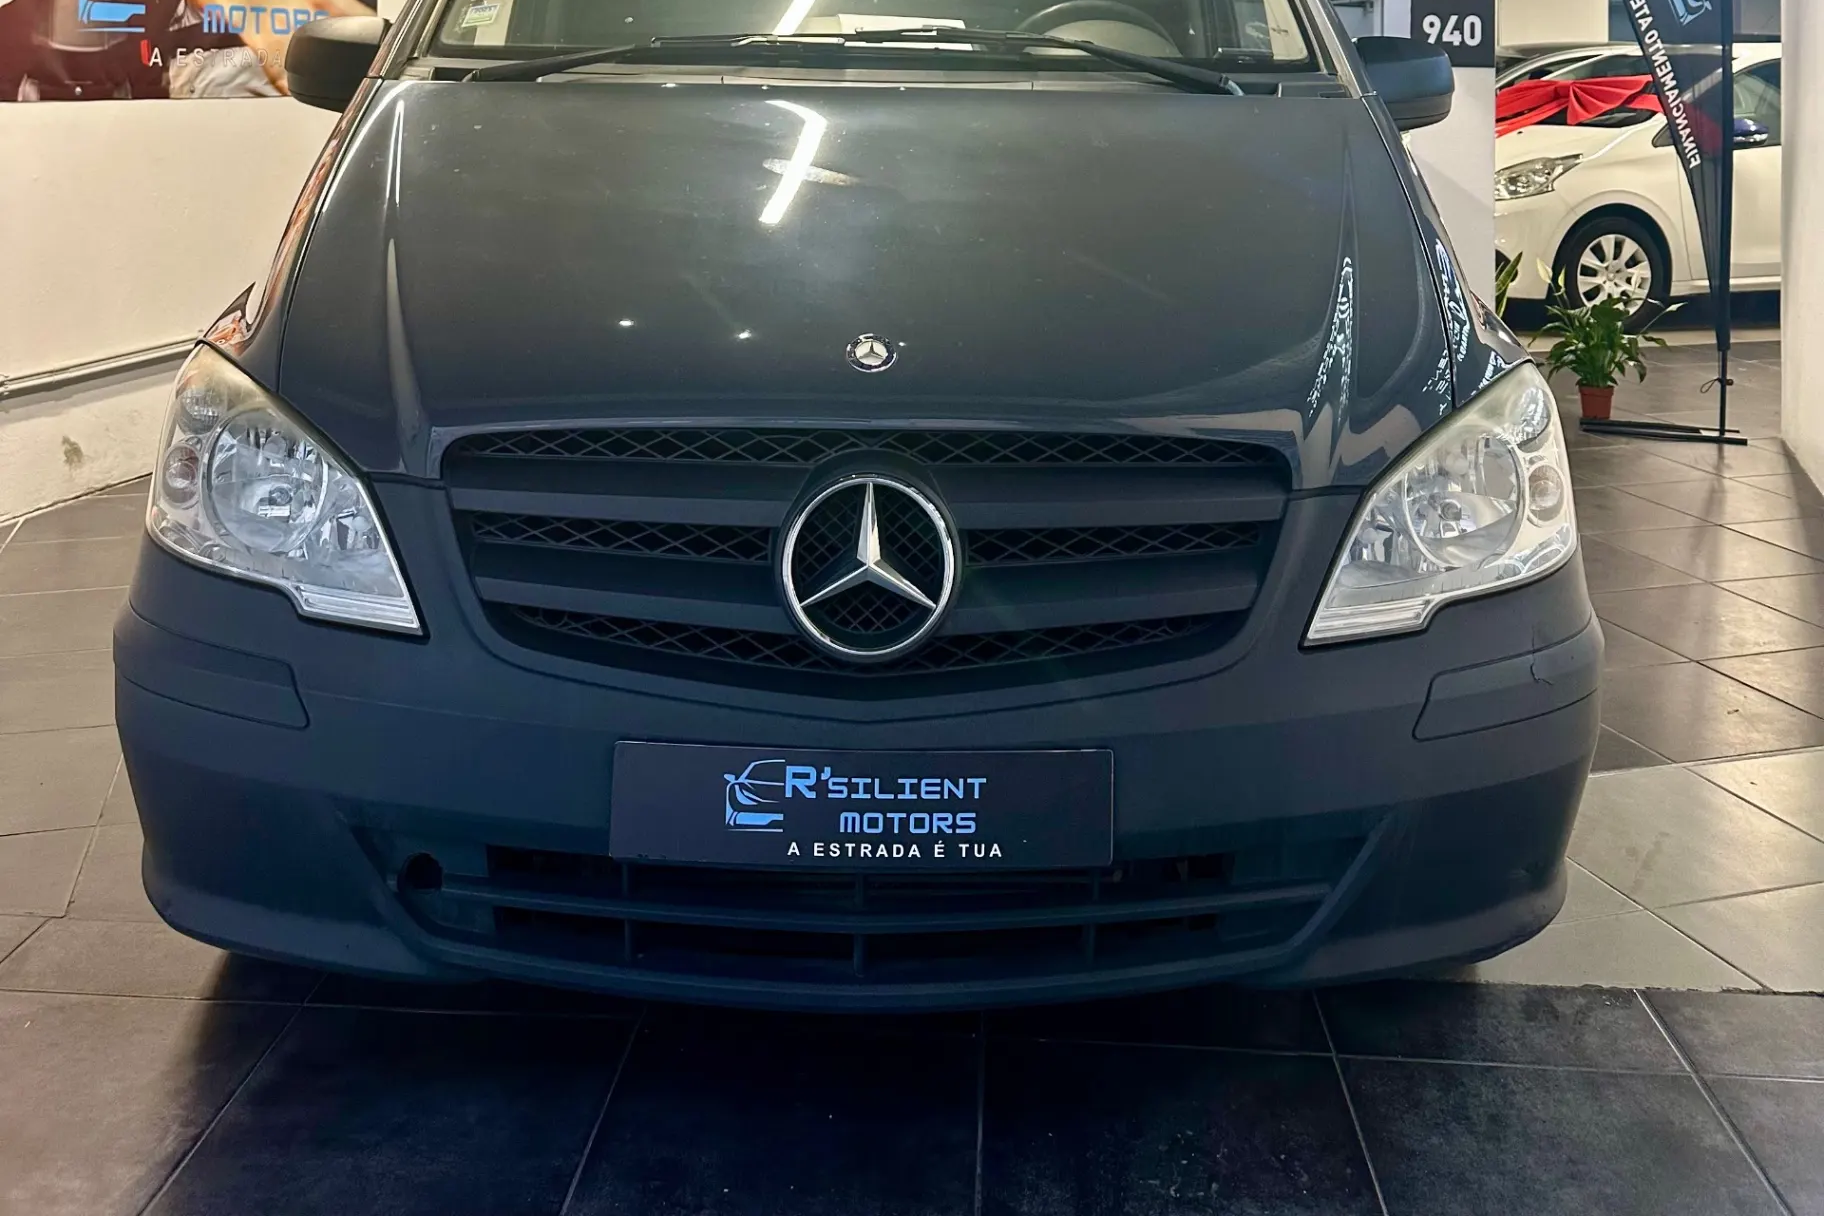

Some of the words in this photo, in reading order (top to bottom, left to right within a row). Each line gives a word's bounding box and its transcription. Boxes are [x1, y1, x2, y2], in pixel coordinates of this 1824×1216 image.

[1422, 15, 1482, 46] 940
[150, 47, 163, 67] A
[176, 47, 285, 68] ESTRADA
[785, 765, 987, 799] R'SILIENT
[839, 811, 976, 834] MOTORS
[787, 842, 800, 856] A
[813, 842, 921, 858] ESTRADA
[934, 840, 945, 858] É
[959, 843, 1002, 858] TUA
